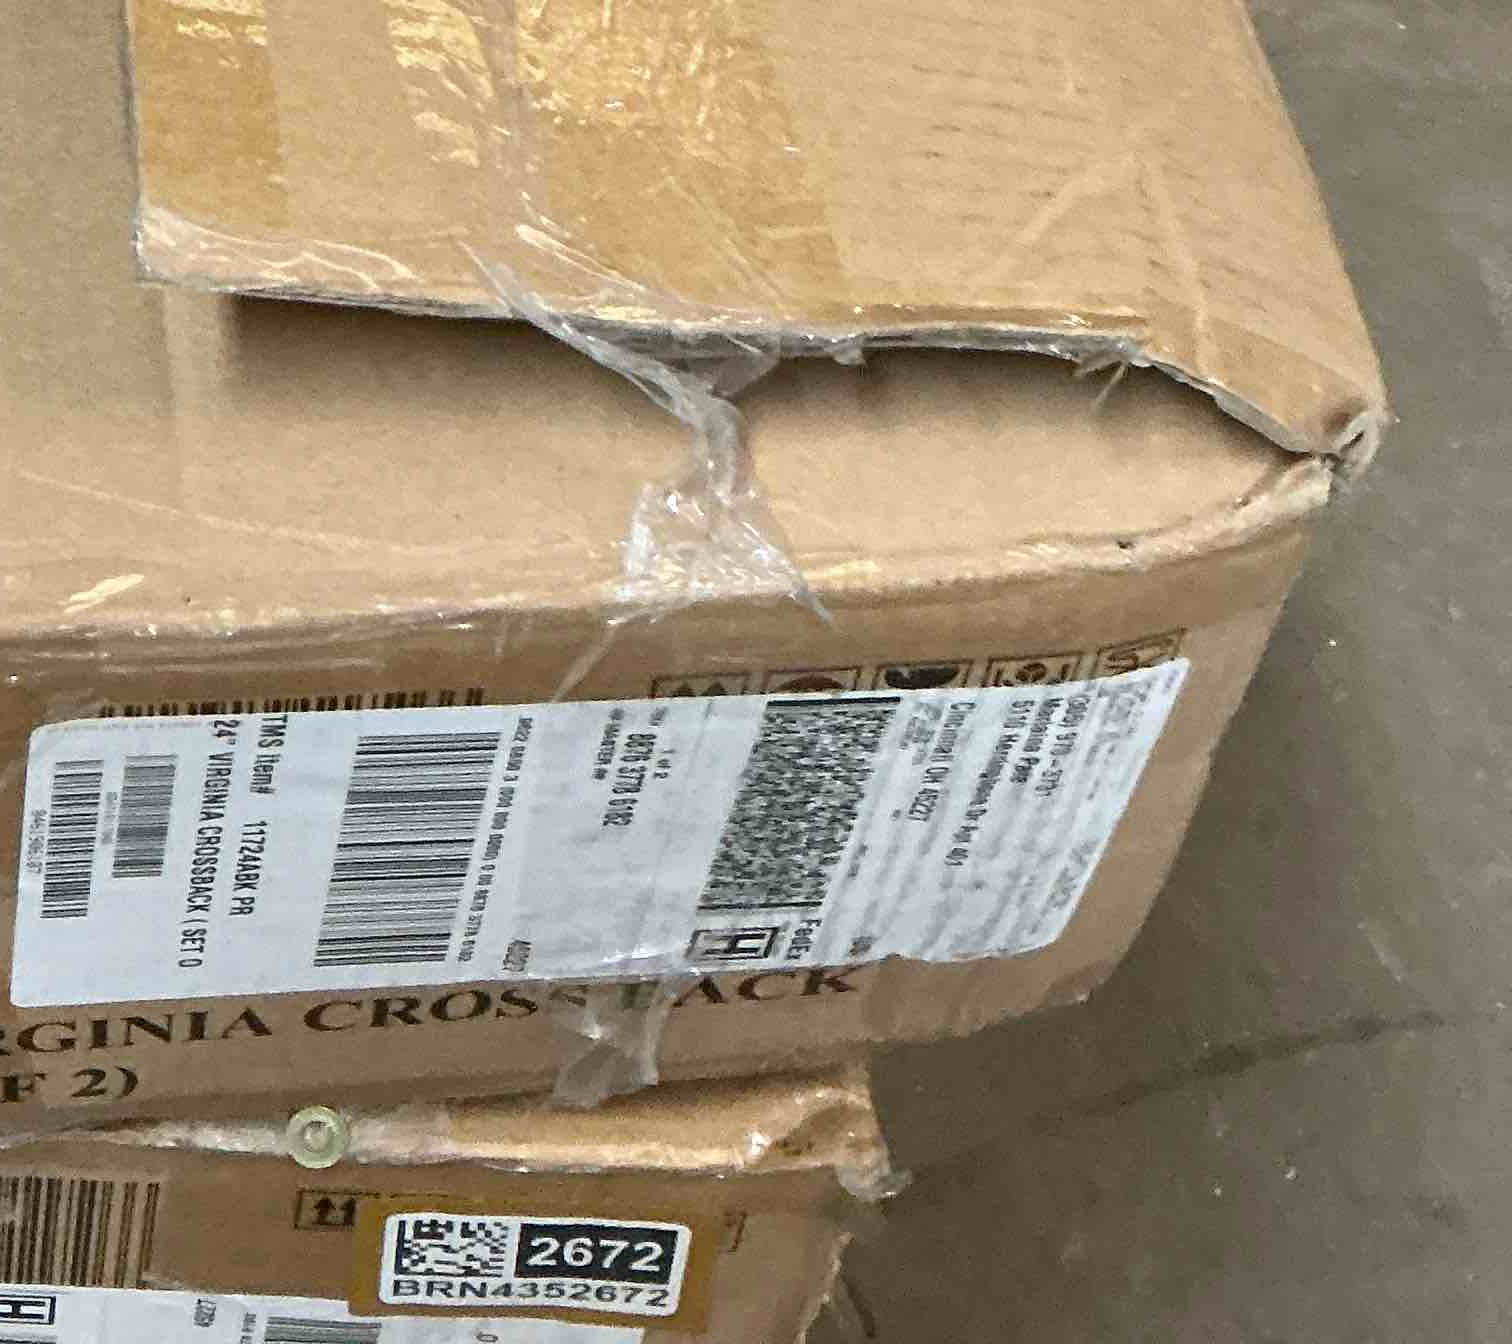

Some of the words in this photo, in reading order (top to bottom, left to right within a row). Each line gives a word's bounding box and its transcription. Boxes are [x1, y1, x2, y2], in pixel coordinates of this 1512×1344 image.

[258, 713, 288, 749] TMS
[198, 751, 235, 823] VIRGINIA
[249, 753, 283, 796] Item#
[186, 825, 225, 914] CROSSBACK
[232, 820, 269, 893] 11724ABK
[228, 895, 256, 918] PR
[179, 927, 208, 954] SET
[786, 919, 823, 961] FedEx
[69, 1064, 140, 1101] 2)
[528, 1236, 662, 1273] 2672
[391, 1278, 672, 1309] BRN4352672
